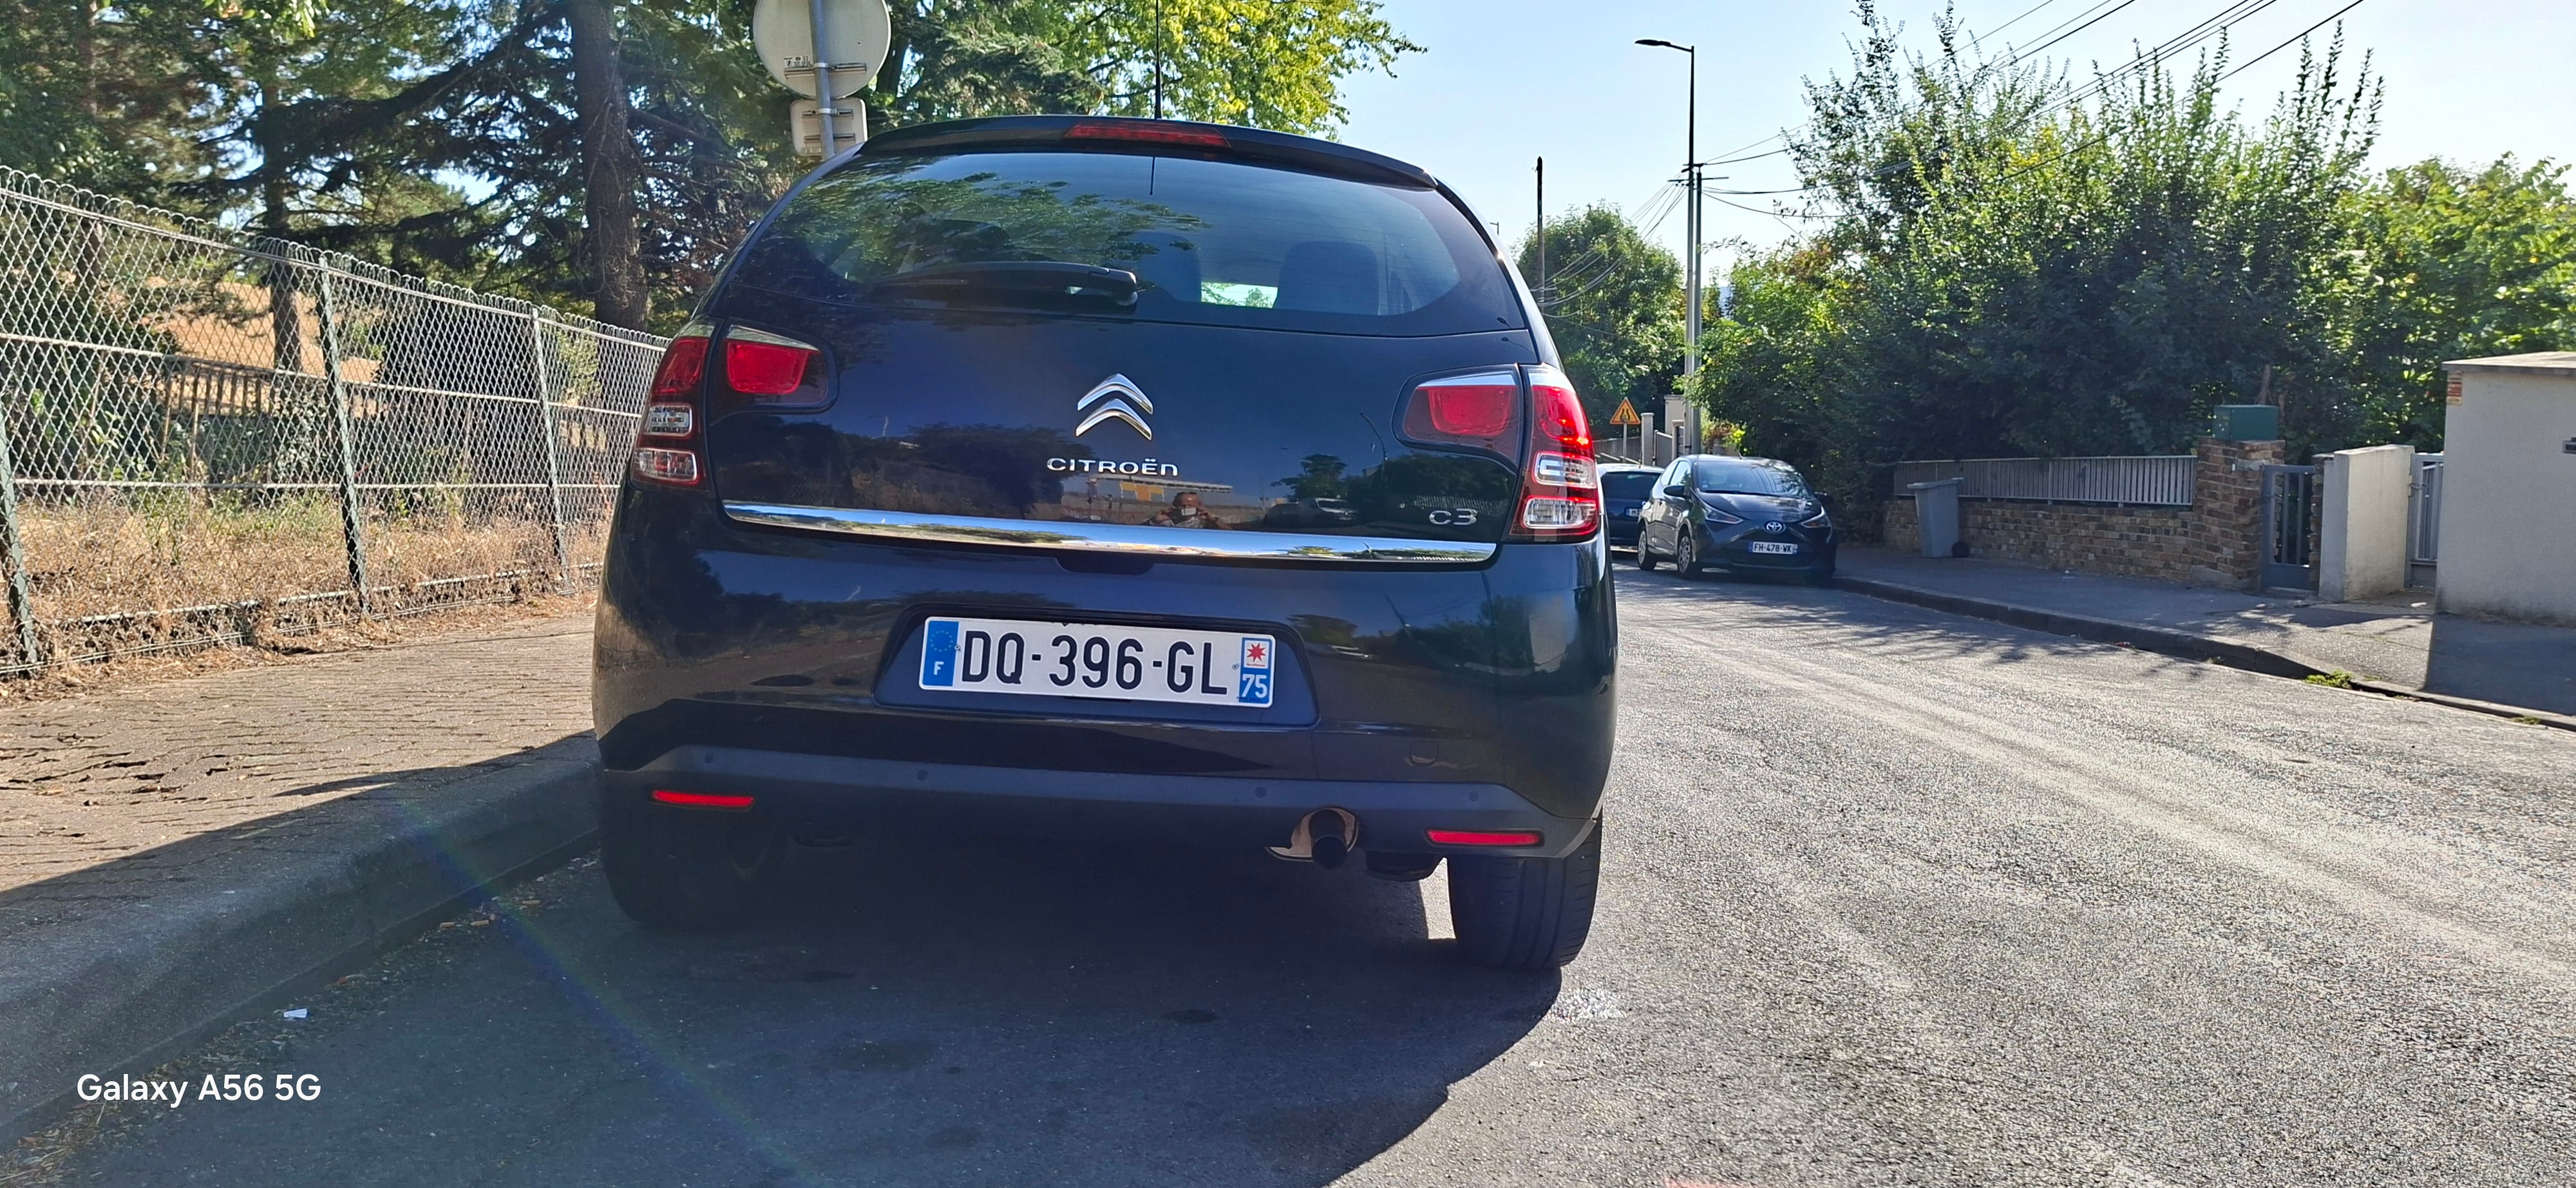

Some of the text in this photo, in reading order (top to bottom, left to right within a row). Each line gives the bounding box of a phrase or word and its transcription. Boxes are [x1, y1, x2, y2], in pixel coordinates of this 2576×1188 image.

[1047, 457, 1178, 476] CITROËN
[1429, 508, 1477, 525] C3
[1754, 543, 1792, 553] FH-478-WK
[934, 661, 944, 675] F
[961, 630, 1227, 695] DQ-396-GL
[1242, 673, 1267, 698] 75
